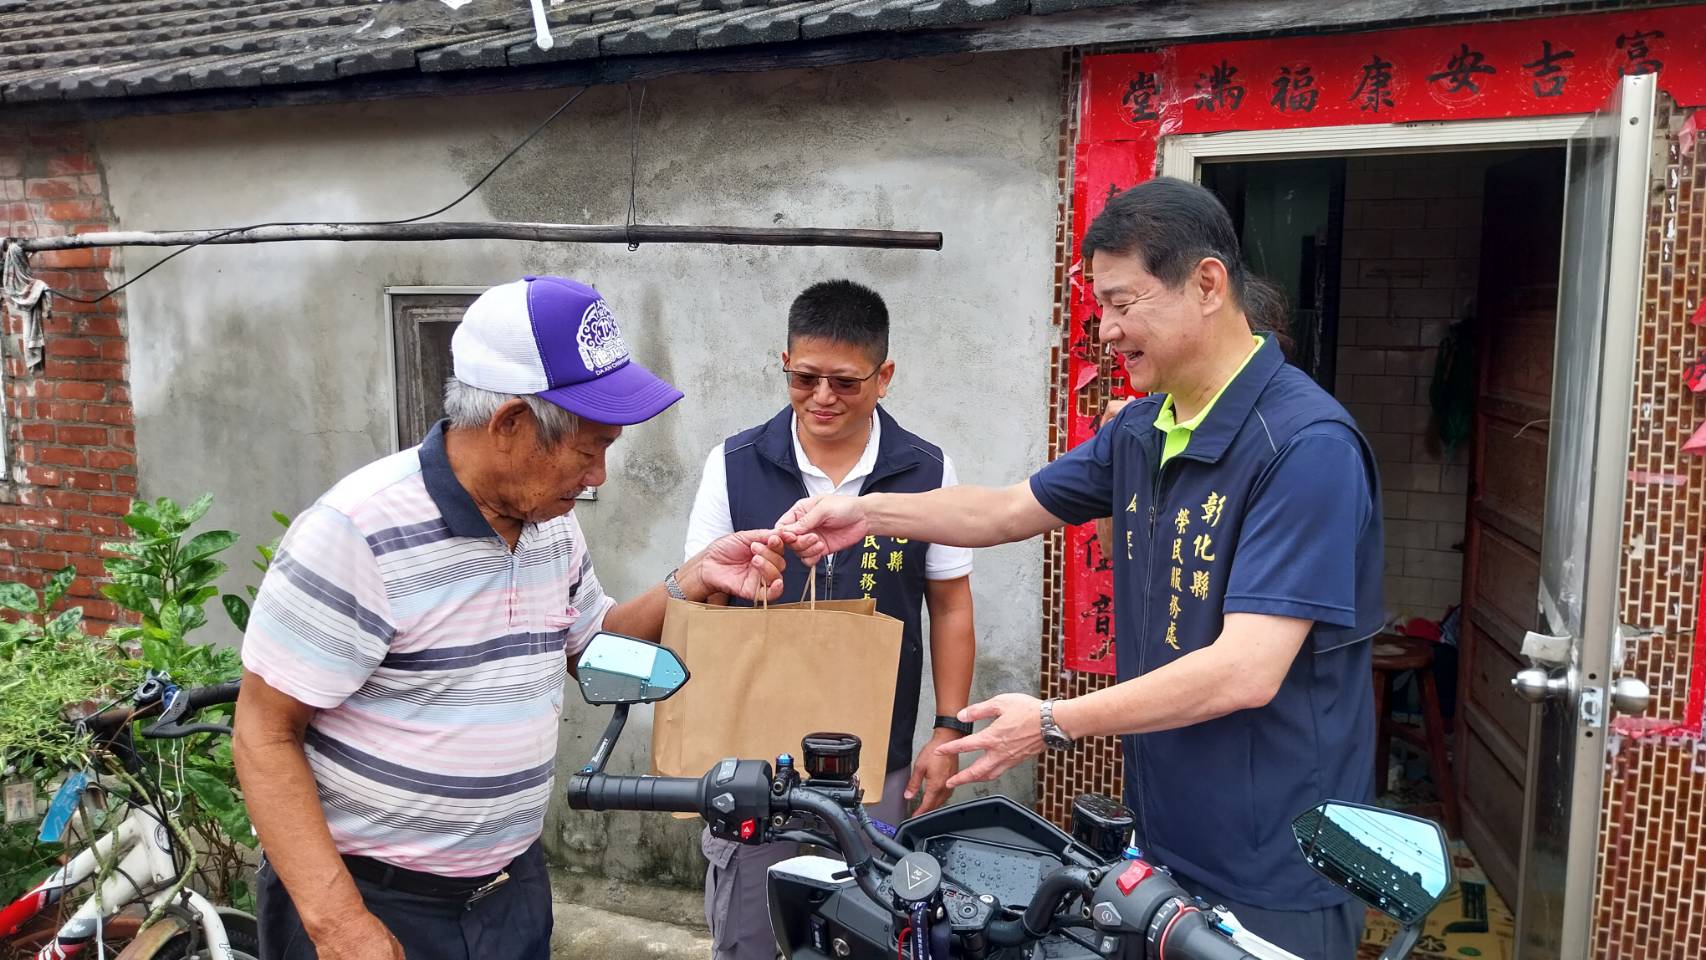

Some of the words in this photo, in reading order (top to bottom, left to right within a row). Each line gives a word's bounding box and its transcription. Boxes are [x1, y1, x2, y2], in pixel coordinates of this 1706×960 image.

[1164, 508, 1190, 650] 榮民服務處
[1190, 491, 1227, 600] 彰化縣
